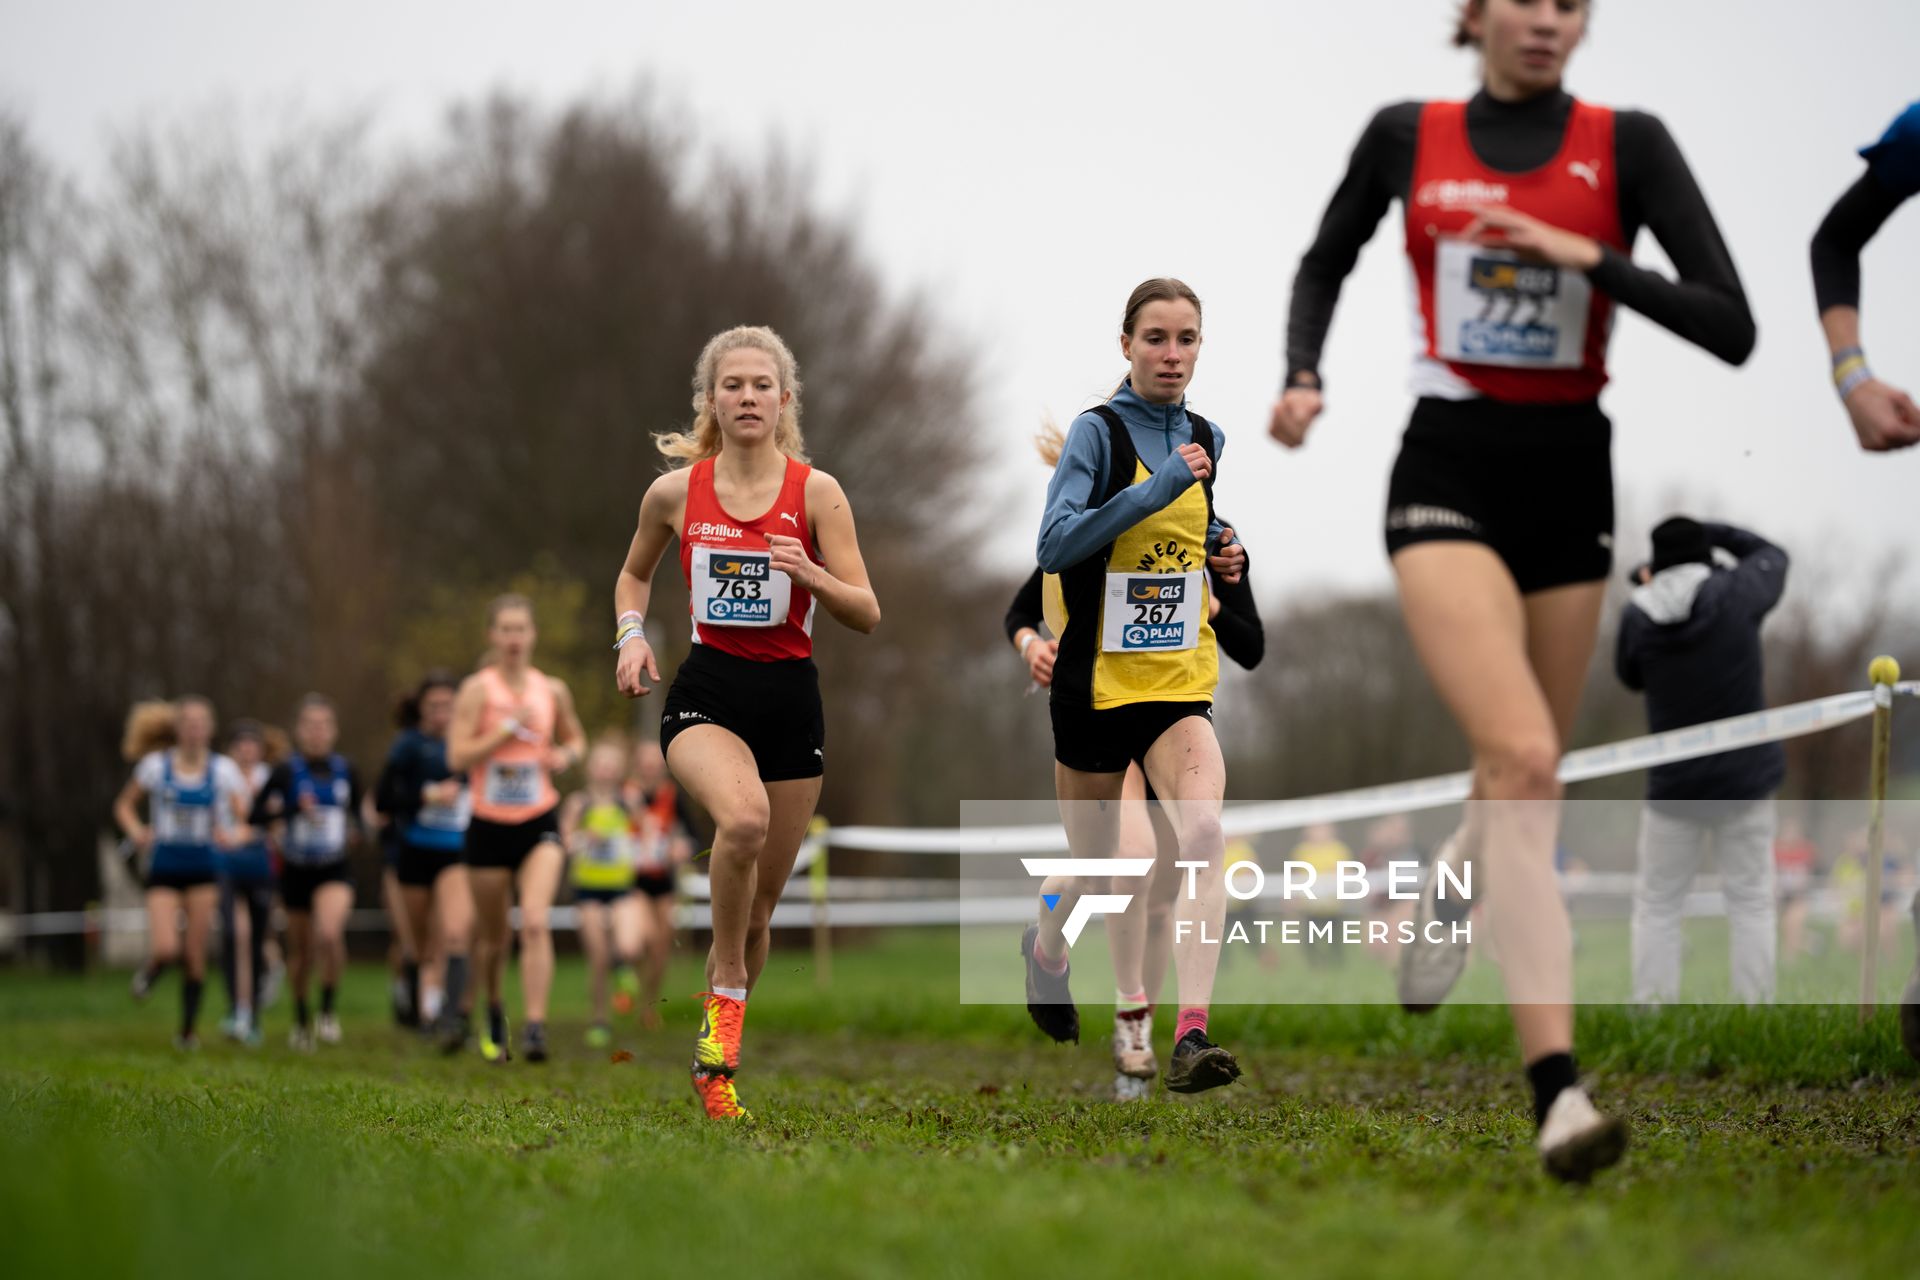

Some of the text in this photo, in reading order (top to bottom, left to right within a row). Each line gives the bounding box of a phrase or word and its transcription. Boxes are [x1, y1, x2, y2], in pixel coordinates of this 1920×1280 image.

[701, 522, 743, 538] Brillux
[740, 562, 765, 577] GLS
[715, 579, 761, 600] 763
[1159, 585, 1182, 600] GLS
[732, 602, 768, 614] PLAN
[1133, 604, 1178, 625] 267
[1150, 627, 1182, 639] PLAN
